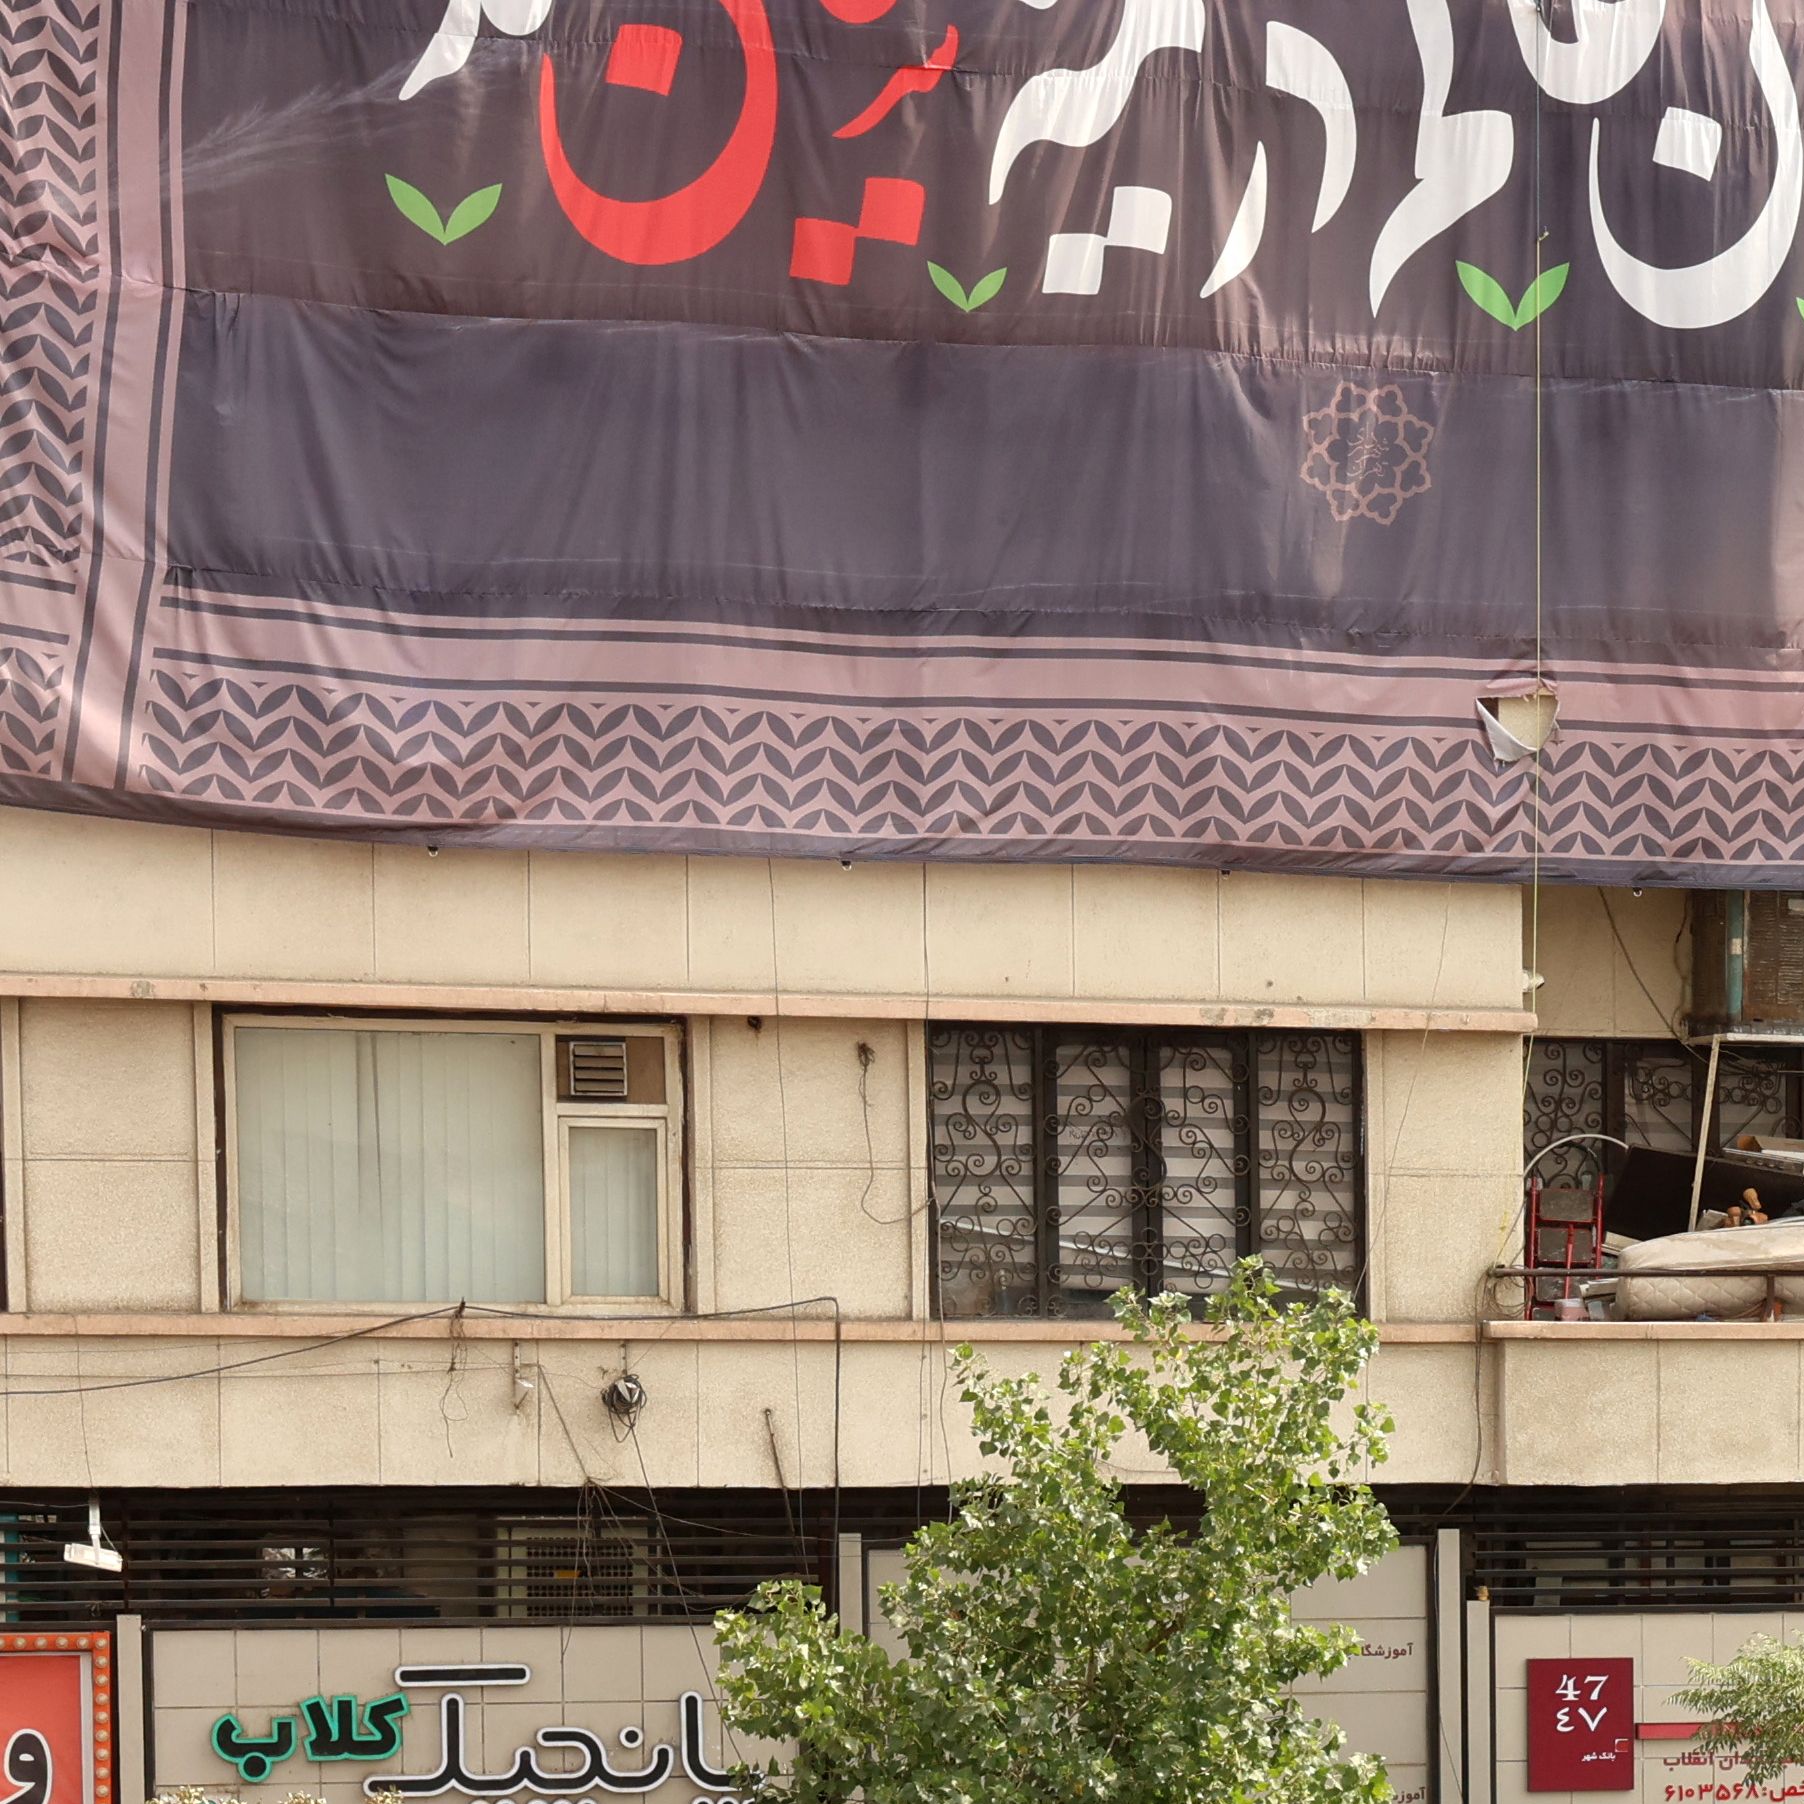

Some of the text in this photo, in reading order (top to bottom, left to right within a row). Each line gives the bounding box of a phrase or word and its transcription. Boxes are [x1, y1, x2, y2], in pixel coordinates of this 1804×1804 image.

[1555, 1674, 1609, 1701] 47
[212, 1693, 410, 1783] کلاب
[1581, 1752, 1616, 1762] بانک شهر
